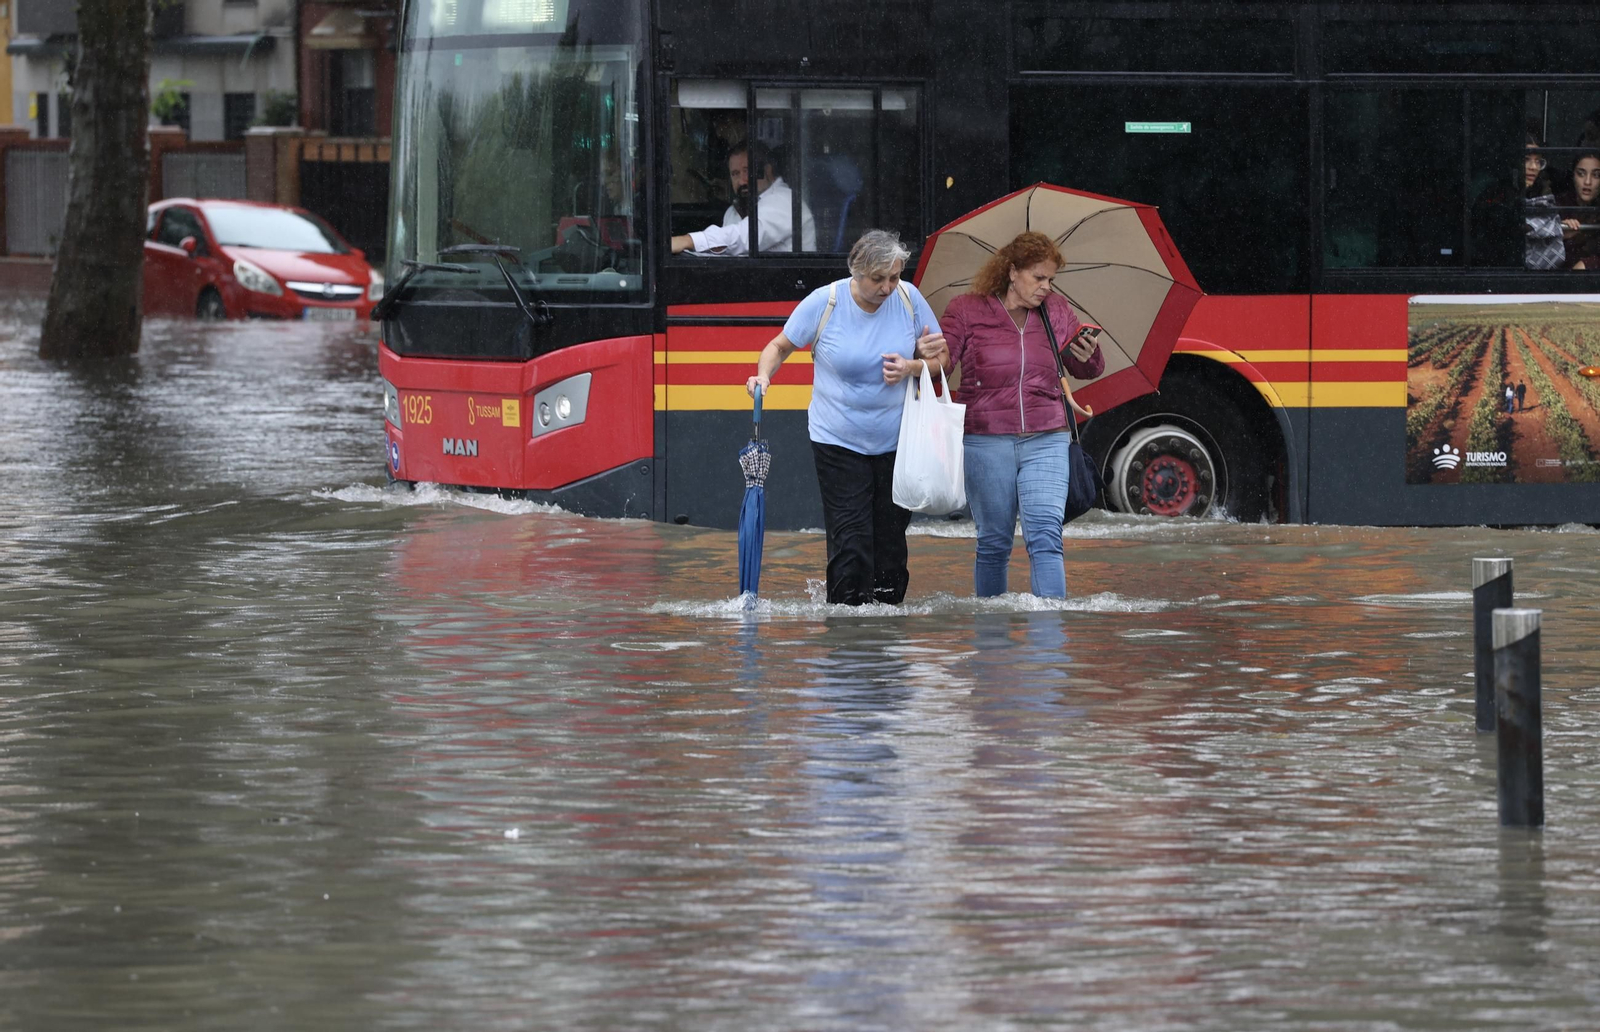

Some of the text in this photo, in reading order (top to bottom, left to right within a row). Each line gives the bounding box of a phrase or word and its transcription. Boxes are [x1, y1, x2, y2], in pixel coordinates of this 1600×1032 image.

[403, 395, 432, 424] 1925
[476, 405, 501, 418] TUSSAM
[442, 437, 478, 456] MAN
[1465, 451, 1507, 462] TURISMO
